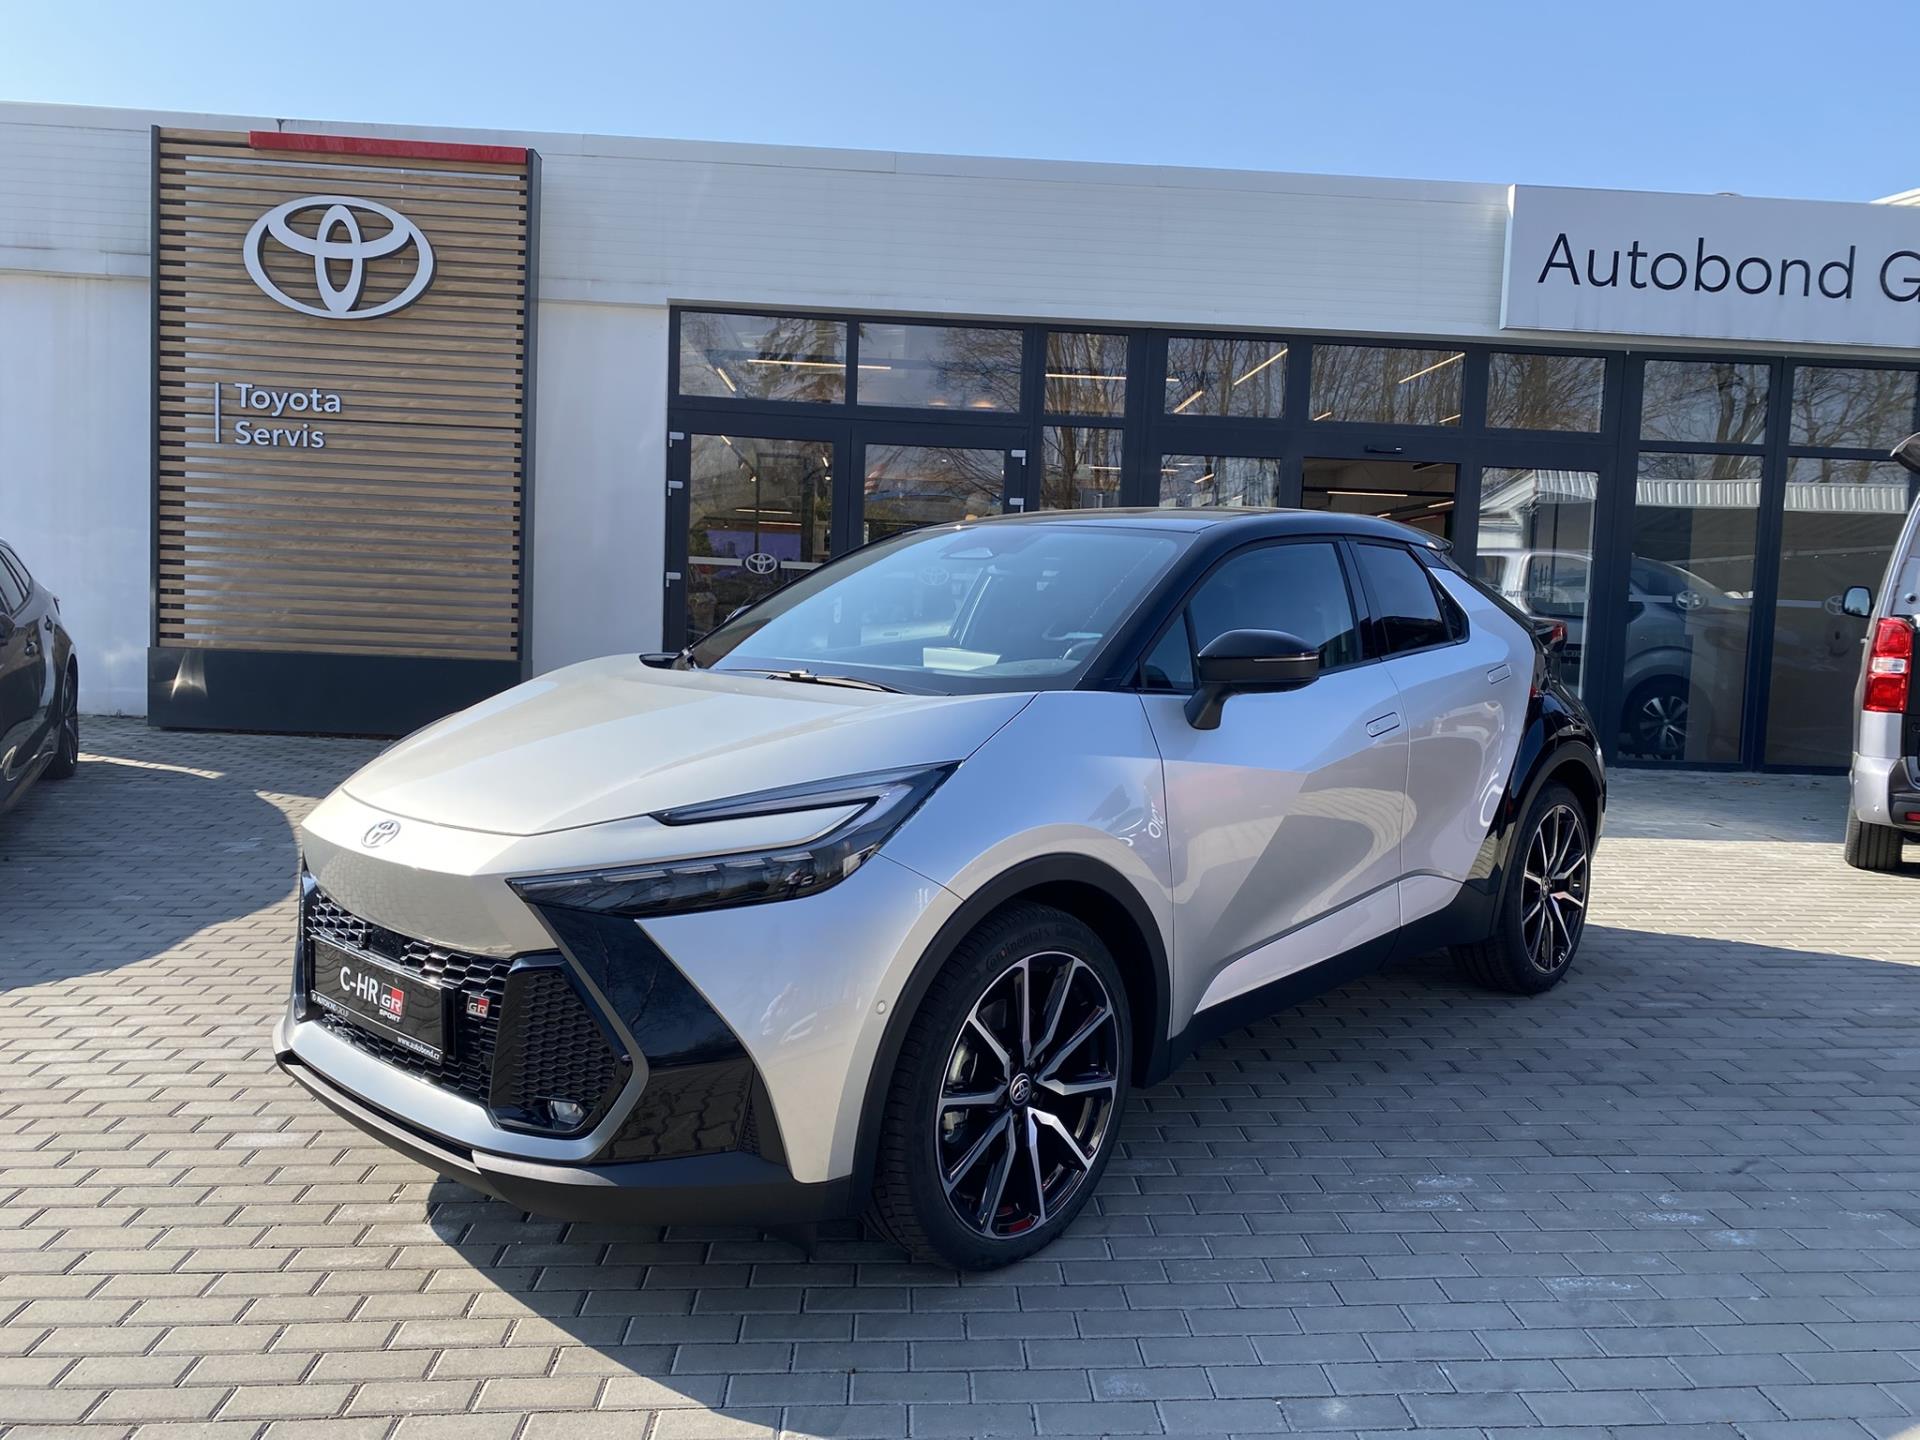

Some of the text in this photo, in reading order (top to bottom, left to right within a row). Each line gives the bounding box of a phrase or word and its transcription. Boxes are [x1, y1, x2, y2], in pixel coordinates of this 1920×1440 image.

[1537, 232, 1857, 300] Autobond
[234, 383, 341, 416] Toyota
[235, 420, 325, 448] Servis
[340, 966, 379, 1005] C-HR
[378, 1008, 401, 1023] SPORT
